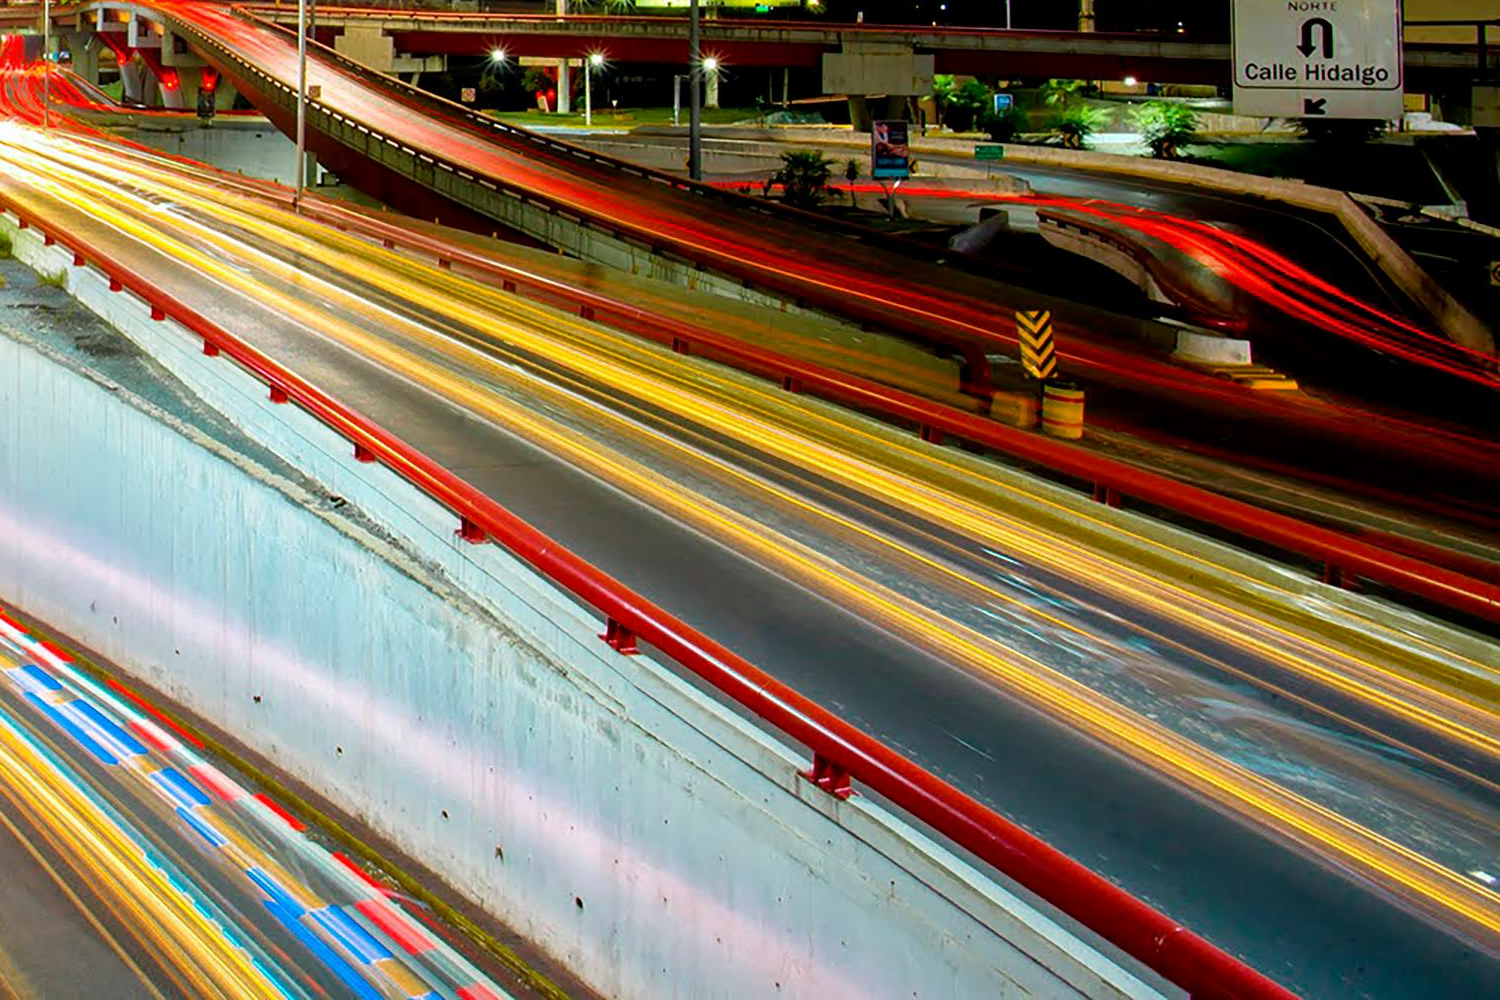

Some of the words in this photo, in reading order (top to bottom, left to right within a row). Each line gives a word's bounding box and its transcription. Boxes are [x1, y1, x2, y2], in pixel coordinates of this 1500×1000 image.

[1288, 1, 1337, 12] NORTE
[1245, 62, 1297, 81] Calle
[1305, 62, 1389, 86] Hidalgo
